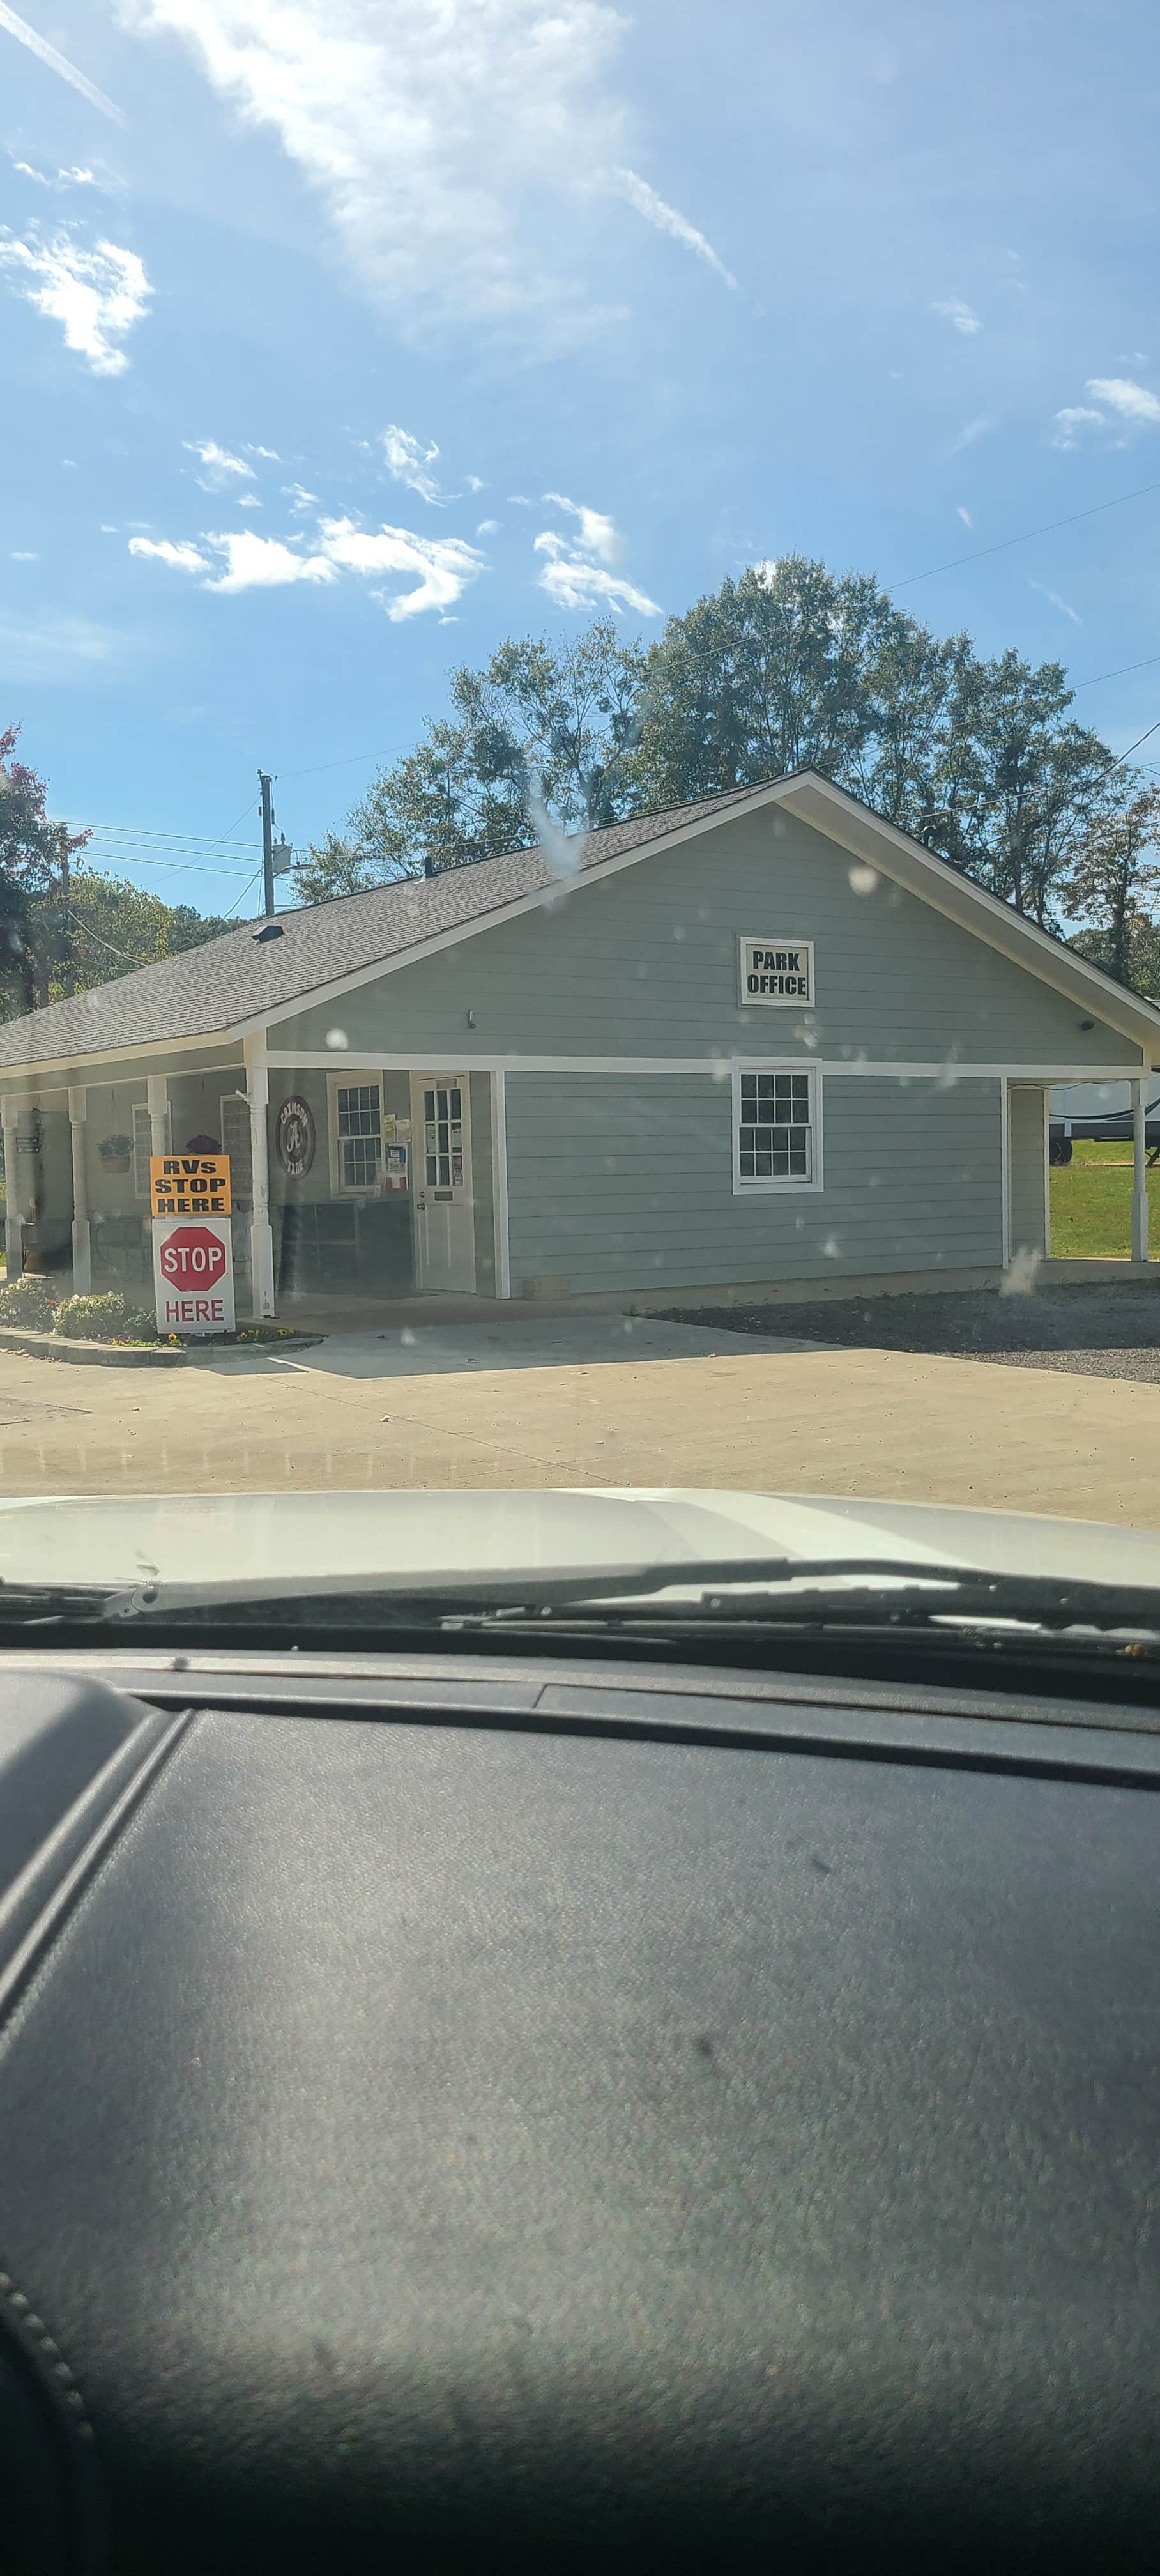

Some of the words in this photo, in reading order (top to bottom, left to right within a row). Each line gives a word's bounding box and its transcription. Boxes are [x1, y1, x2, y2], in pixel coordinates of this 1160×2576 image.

[752, 951, 800, 971] PARK
[747, 974, 806, 995] OFFICE
[163, 1160, 217, 1175] RVs
[155, 1178, 225, 1193] STOP
[158, 1198, 225, 1213] HERE
[164, 1247, 222, 1273] STOP
[166, 1300, 224, 1322] HERE
